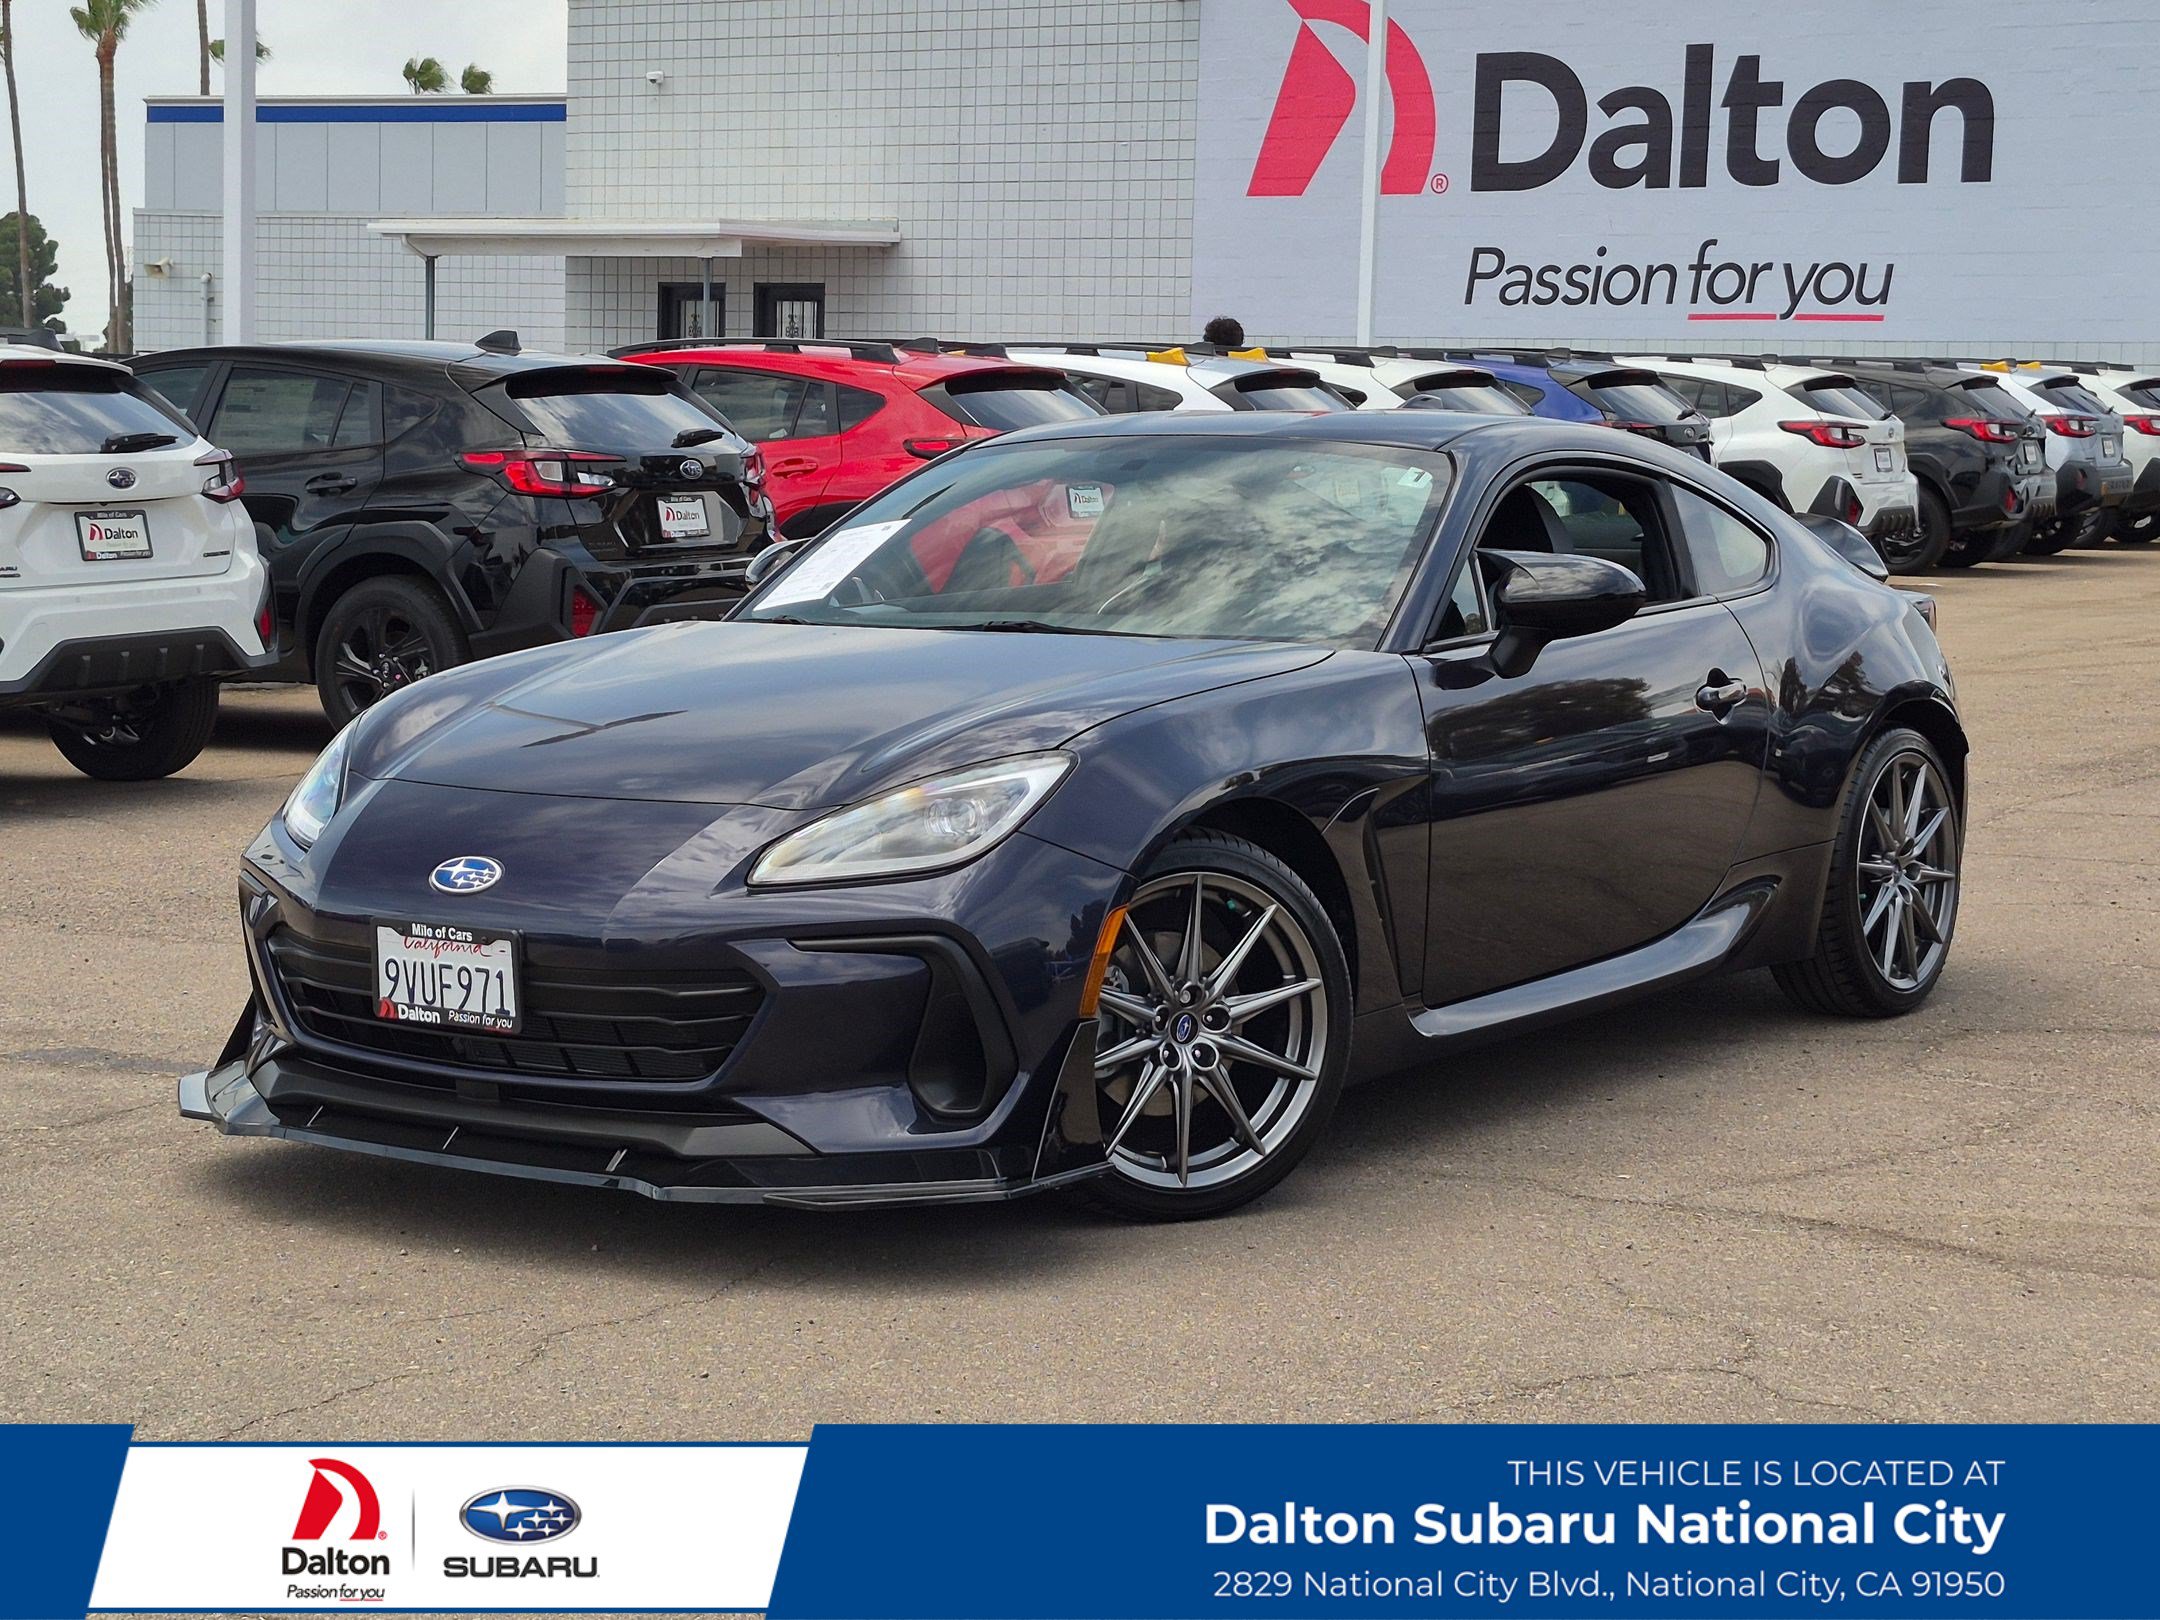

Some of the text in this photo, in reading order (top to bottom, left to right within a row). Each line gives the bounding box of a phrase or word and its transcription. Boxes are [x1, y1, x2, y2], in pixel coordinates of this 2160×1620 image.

[1471, 44, 1994, 191] Dalton
[1464, 239, 1894, 320] Passion for you
[676, 510, 700, 521] Dalton
[104, 527, 139, 540] Dalton
[411, 923, 473, 942] Mile of Cars
[402, 936, 492, 959] California
[384, 957, 511, 1016] 9VUF971
[397, 1004, 441, 1024] Dalton
[448, 1010, 513, 1029] Passion for you
